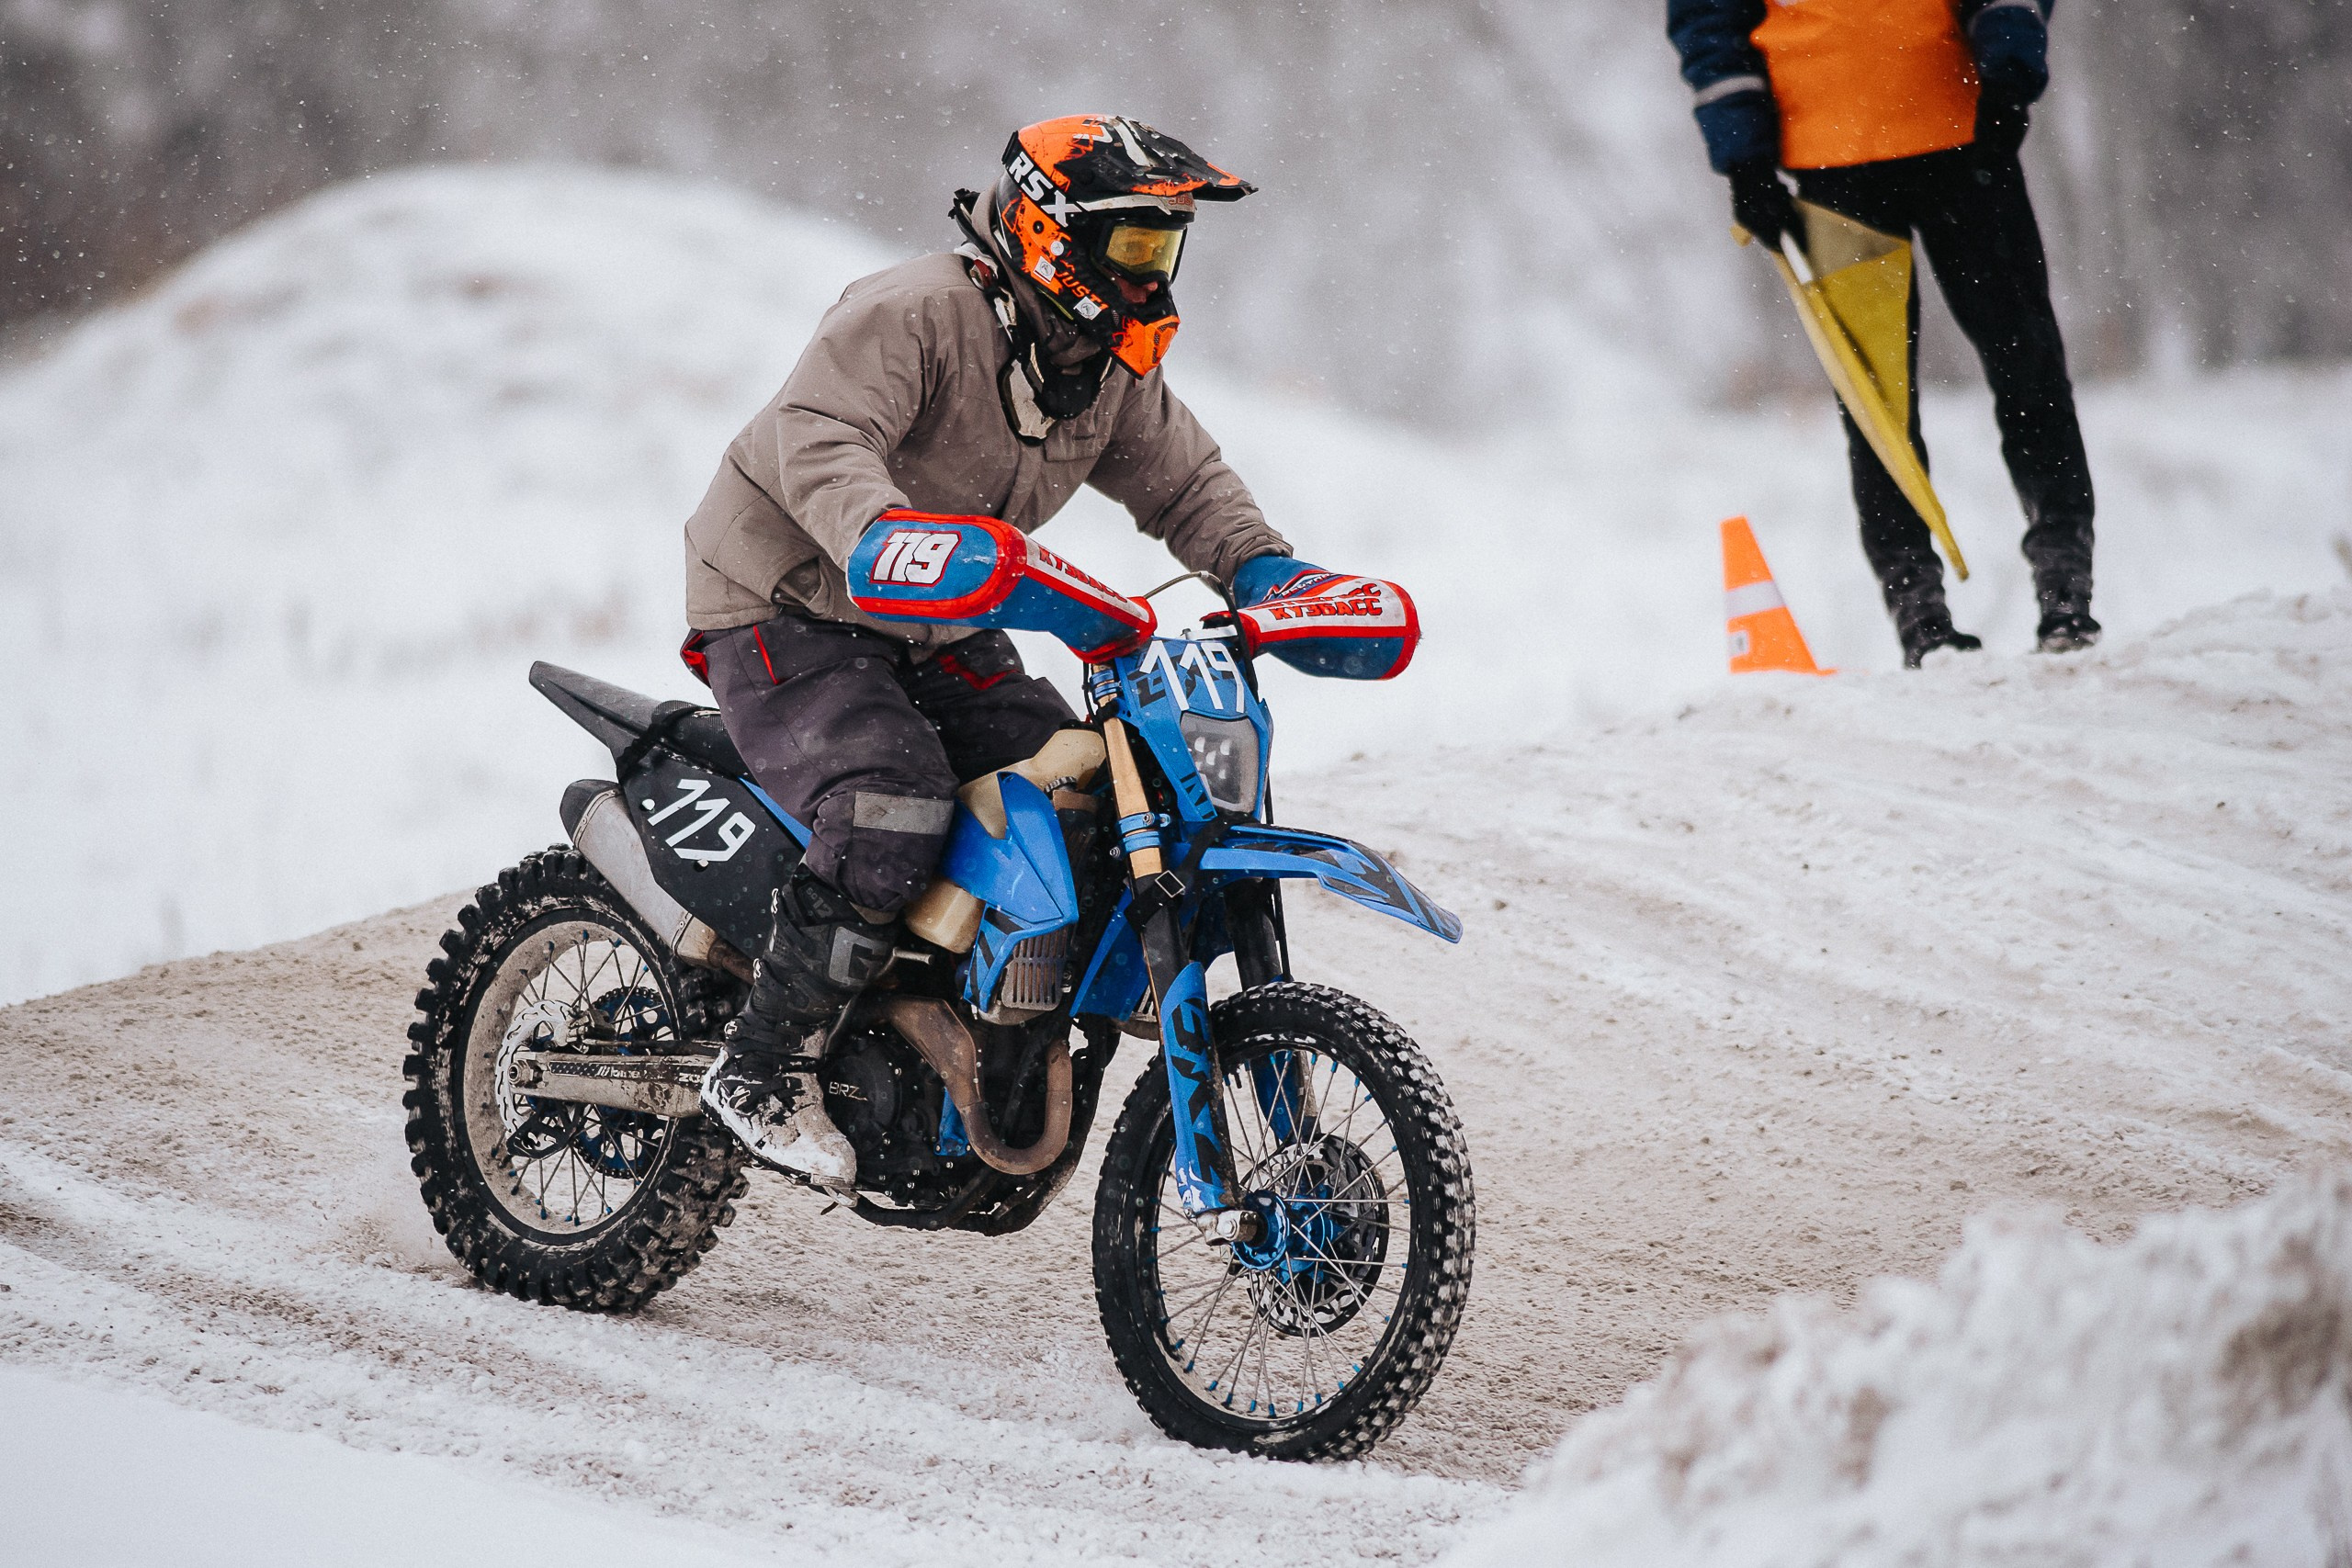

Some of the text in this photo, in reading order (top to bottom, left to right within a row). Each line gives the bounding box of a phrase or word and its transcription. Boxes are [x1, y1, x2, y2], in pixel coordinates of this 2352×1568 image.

[1008, 152, 1082, 227] RSX
[873, 531, 961, 585] 119
[1269, 597, 1383, 621] КУЗБАСС
[1138, 639, 1245, 714] 119
[647, 778, 756, 862] 119
[828, 1081, 868, 1101] BRZ
